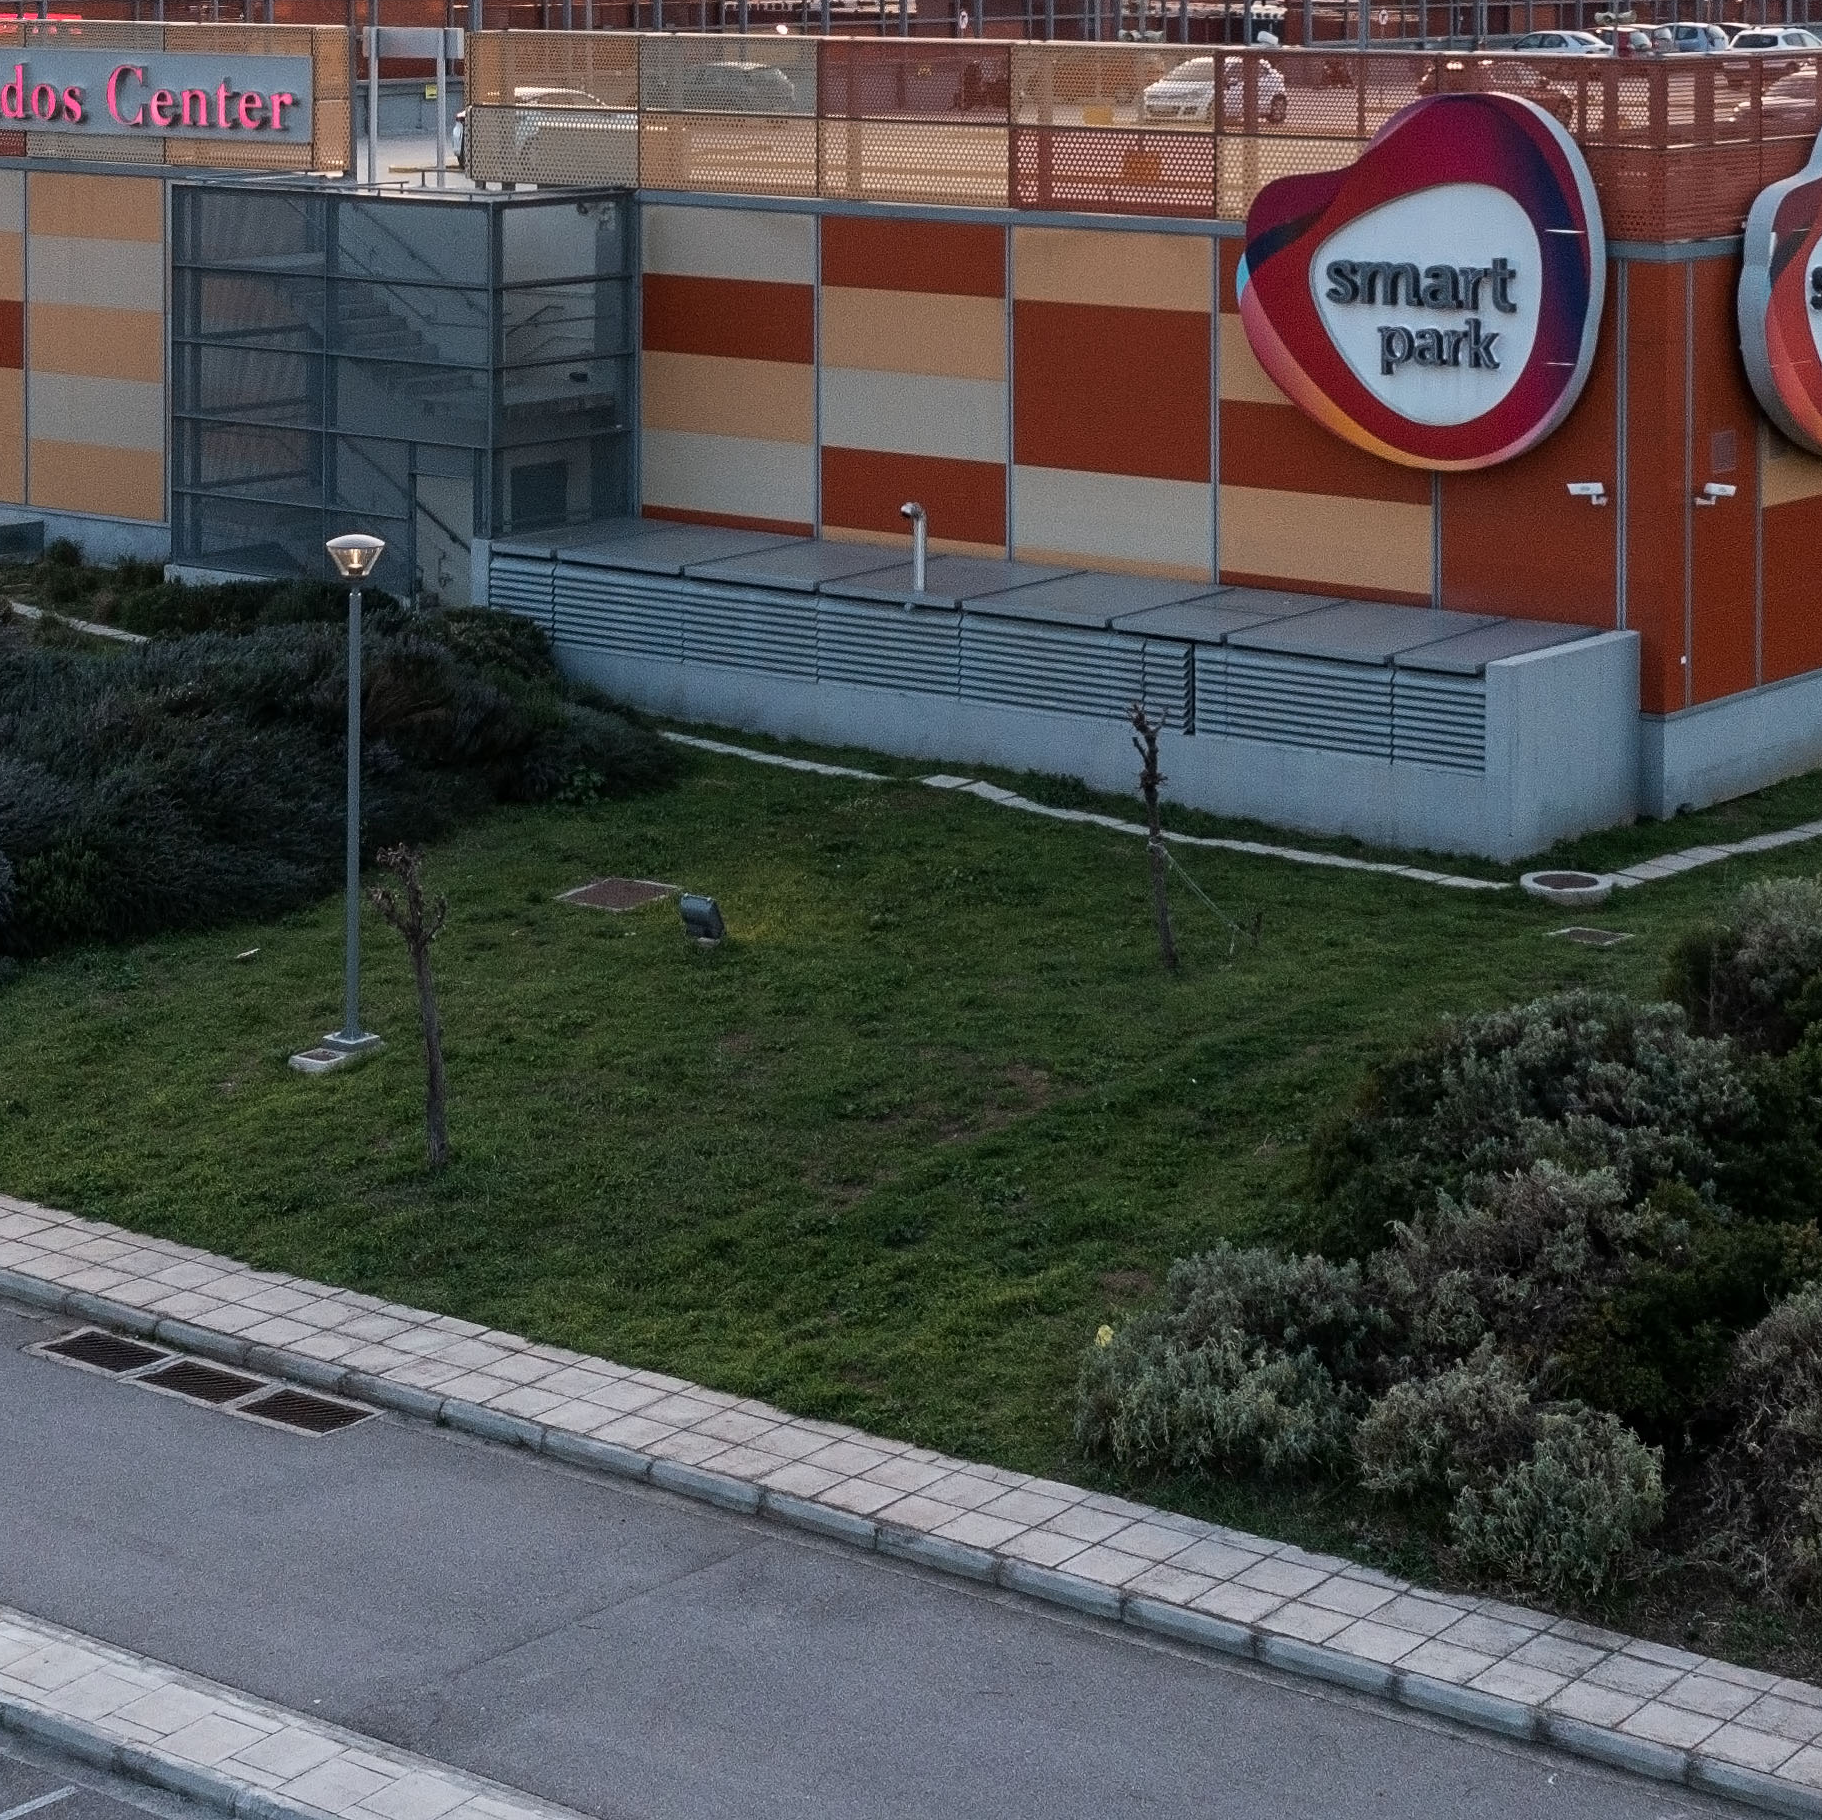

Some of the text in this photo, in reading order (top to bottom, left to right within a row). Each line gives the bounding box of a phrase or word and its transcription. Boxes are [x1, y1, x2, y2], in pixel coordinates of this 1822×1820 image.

[107, 64, 295, 130] Center
[1326, 257, 1518, 313] smart
[1377, 318, 1501, 375] park
